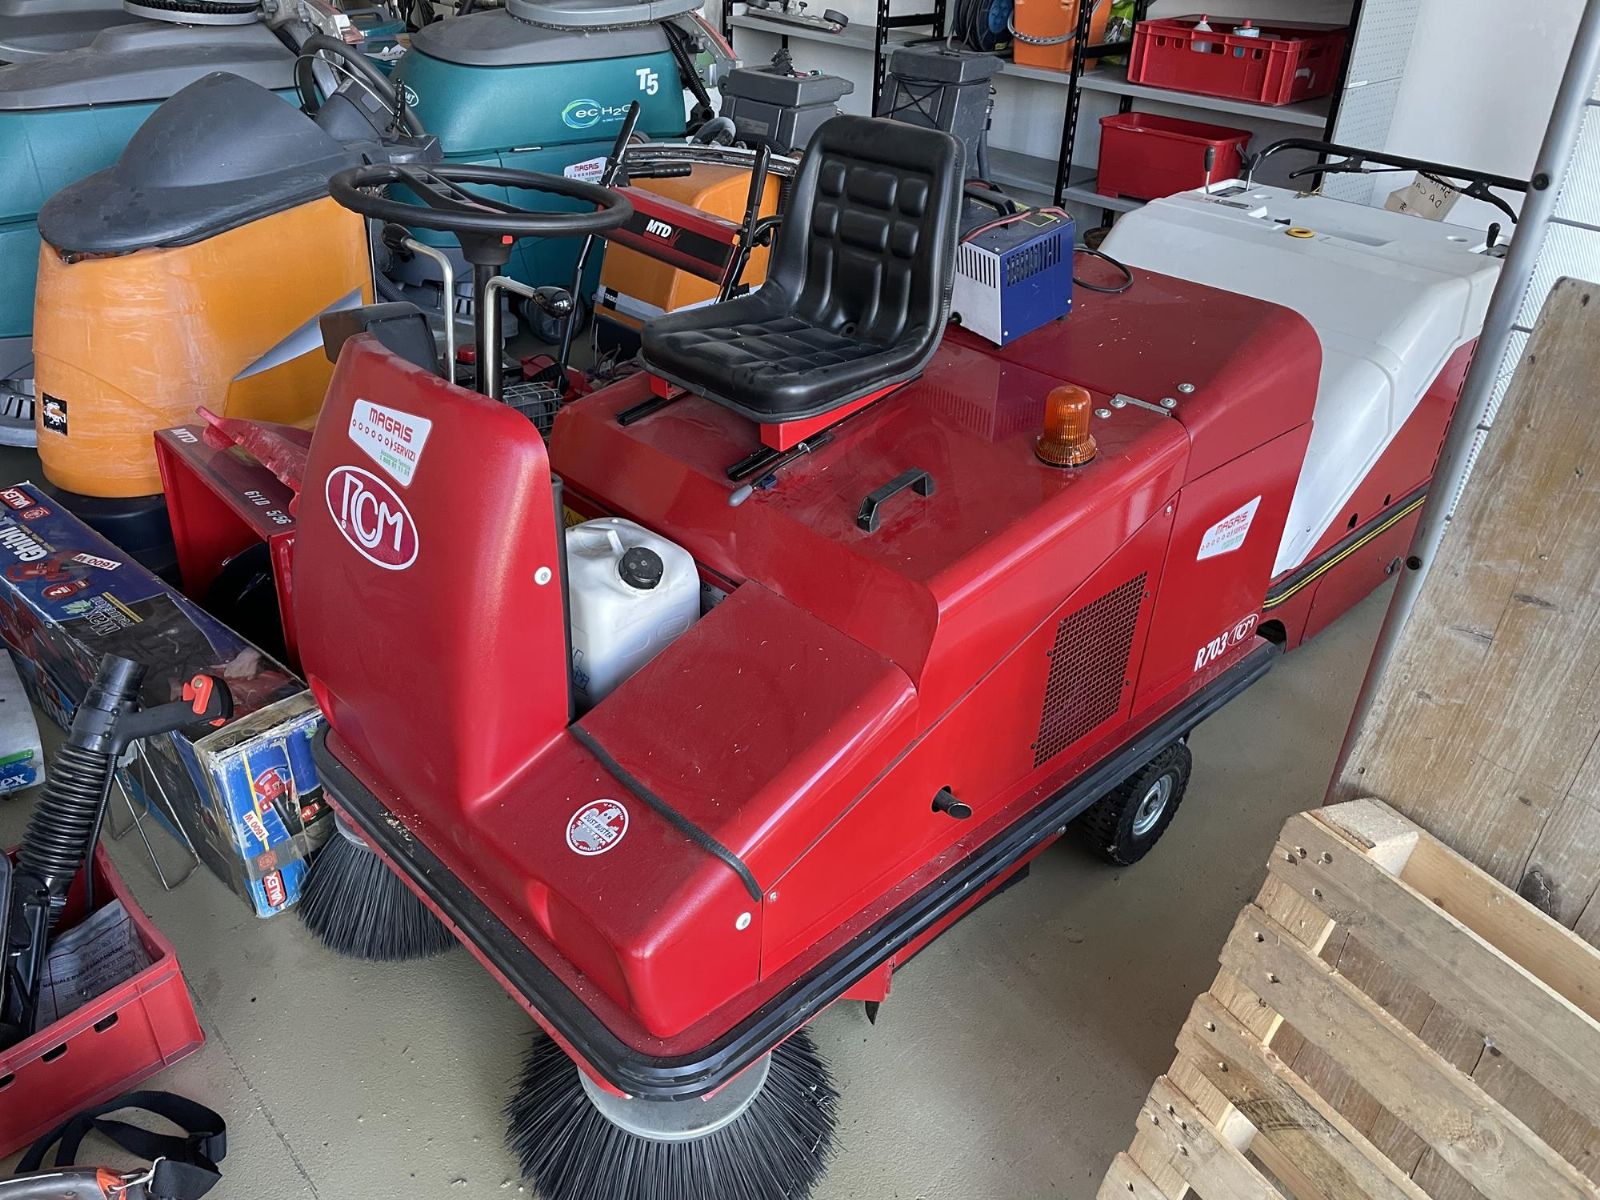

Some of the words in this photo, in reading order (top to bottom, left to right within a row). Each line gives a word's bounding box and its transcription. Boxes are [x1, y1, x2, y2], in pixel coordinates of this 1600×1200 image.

[636, 68, 659, 95] T5
[574, 162, 599, 172] MAGRIS
[646, 219, 672, 238] MTD
[170, 428, 198, 443] MTD
[369, 407, 413, 443] MAGRIS
[1, 488, 31, 509] VALEX
[1215, 511, 1248, 535] MAGRIS
[87, 557, 117, 570] 1600
[1194, 631, 1229, 673] R703
[250, 821, 265, 840] 1600
[584, 814, 598, 826] DUST
[595, 823, 614, 839] BUSTER
[264, 873, 283, 906] VALEX
